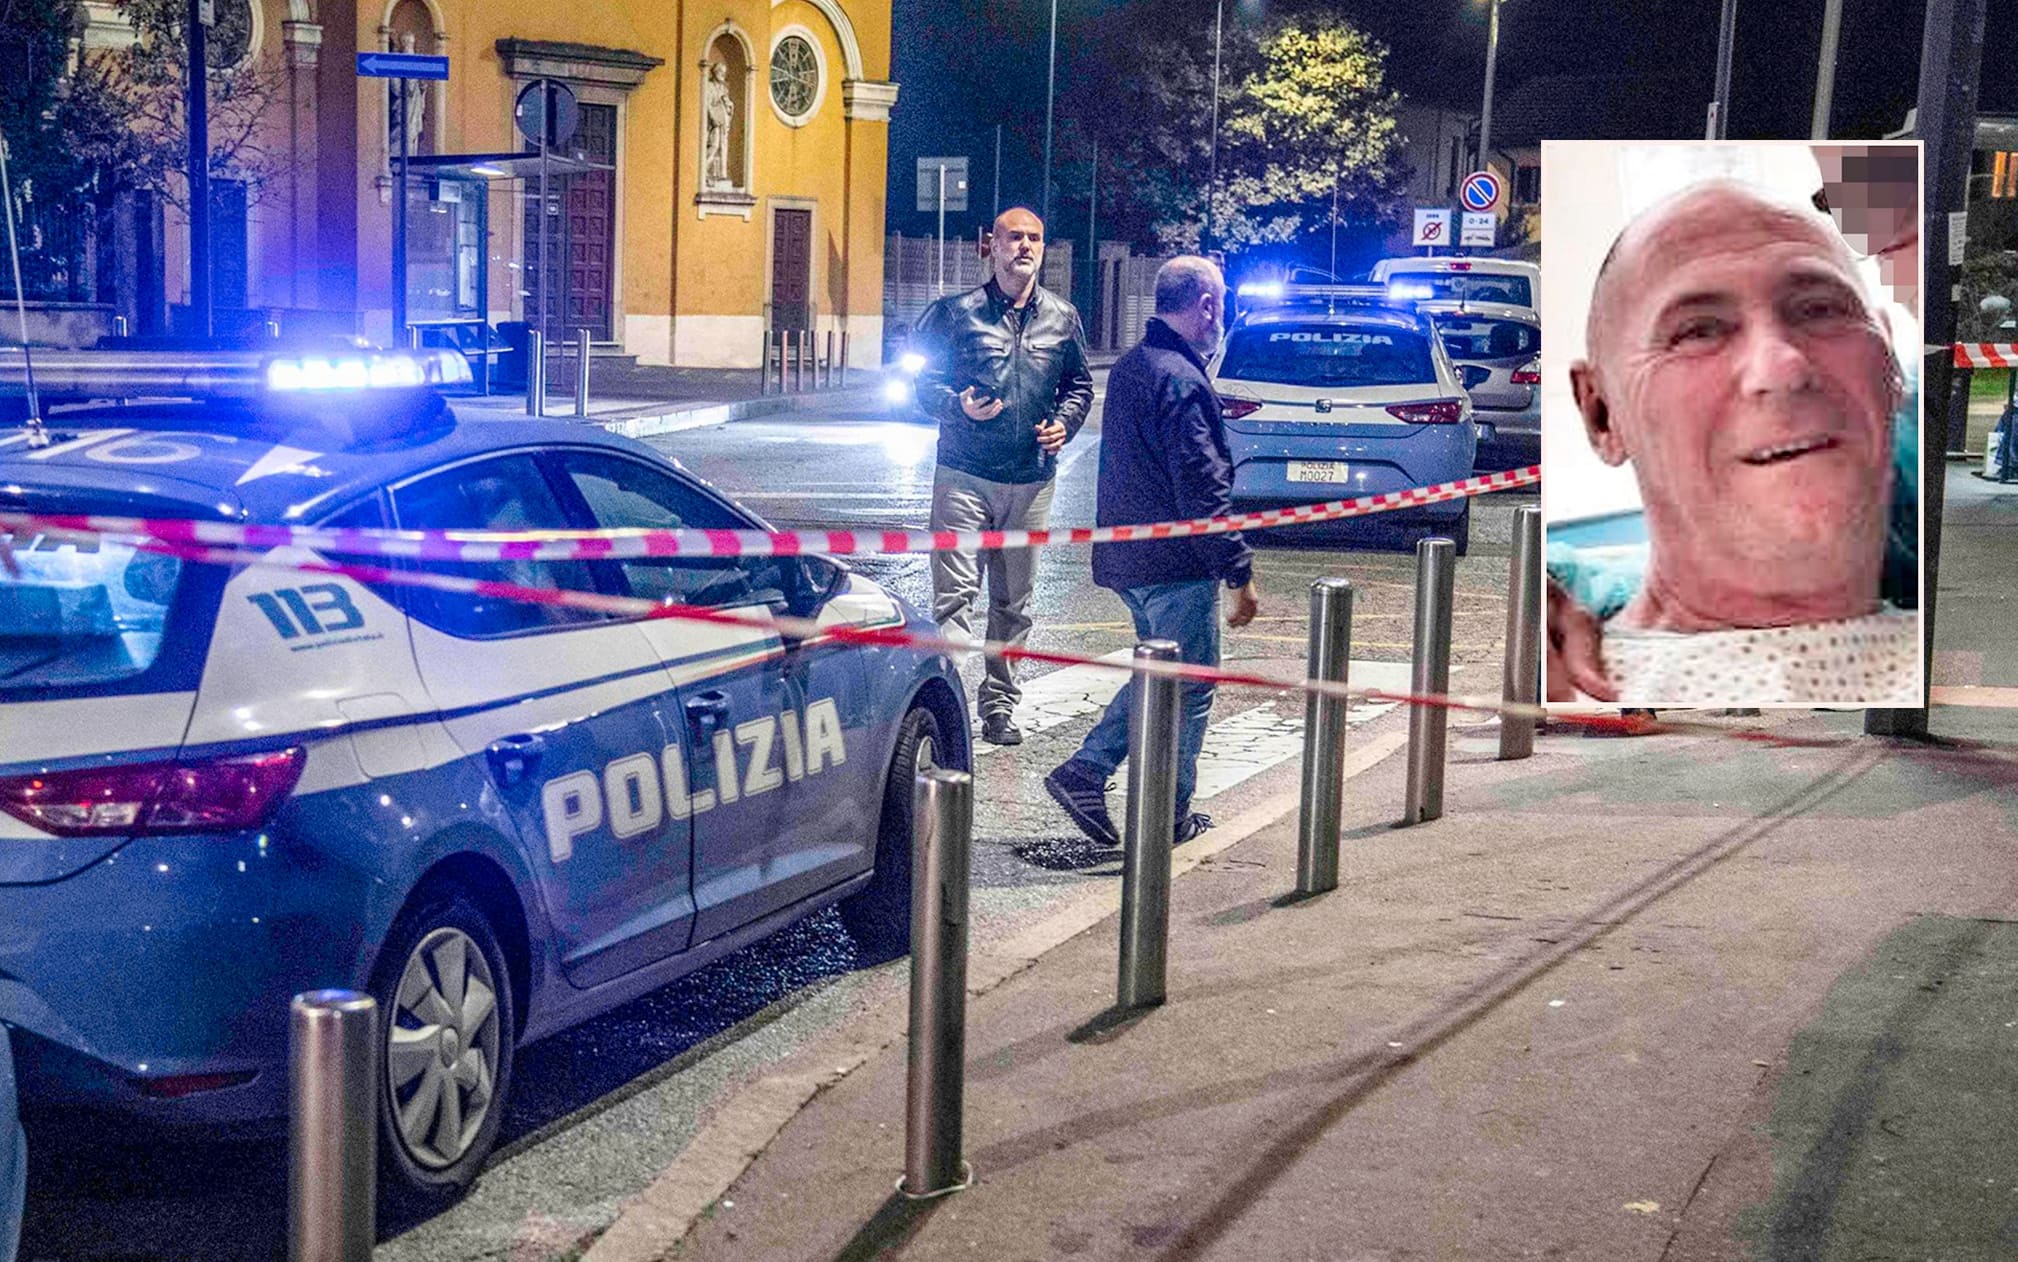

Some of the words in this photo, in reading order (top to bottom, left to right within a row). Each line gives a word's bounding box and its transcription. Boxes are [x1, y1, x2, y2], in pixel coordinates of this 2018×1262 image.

[1269, 332, 1393, 345] POLIZIA
[246, 582, 366, 640] 113
[541, 696, 847, 864] POLIZIA
